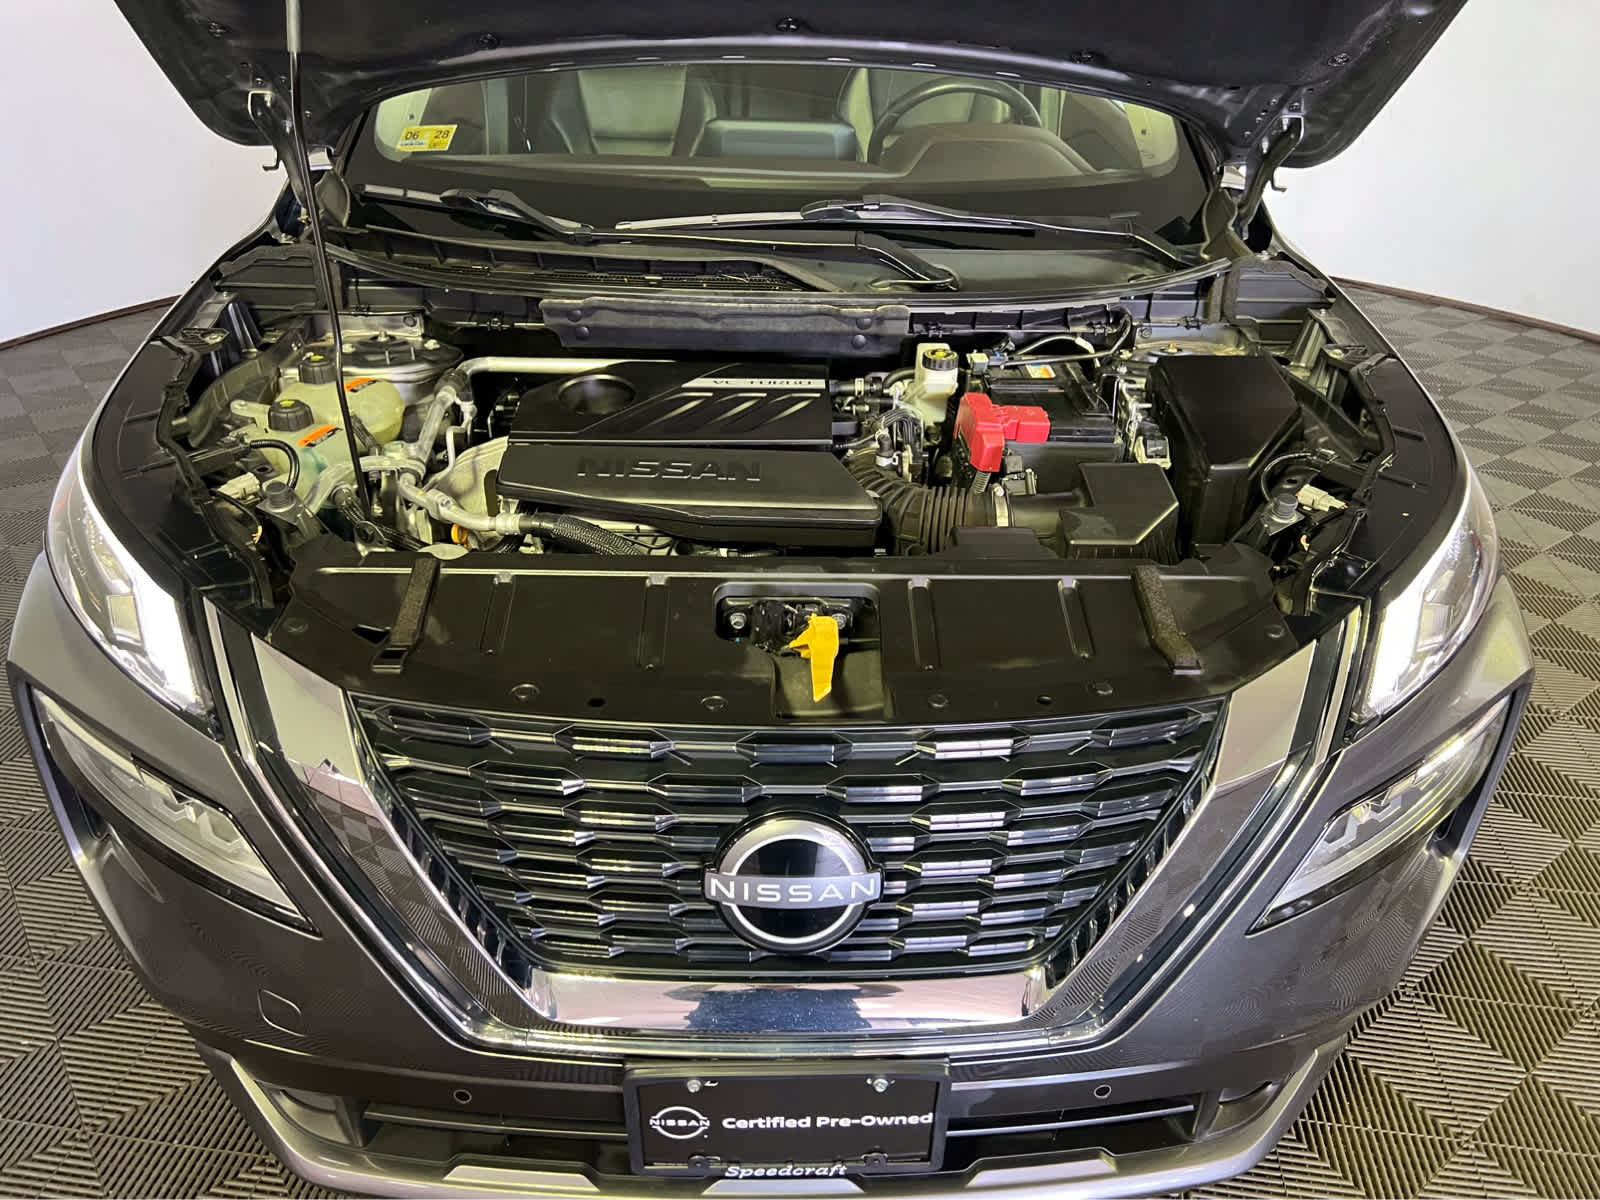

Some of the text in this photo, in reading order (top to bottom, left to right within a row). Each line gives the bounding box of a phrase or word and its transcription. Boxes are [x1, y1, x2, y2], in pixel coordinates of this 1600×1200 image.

[404, 129, 450, 141] 06 28
[577, 455, 761, 481] NISSAN
[710, 878, 875, 903] NISSAN
[649, 1118, 710, 1127] NISSAN
[722, 1112, 934, 1129] Certified Pre-Owned
[724, 1164, 847, 1179] Speedcraft
